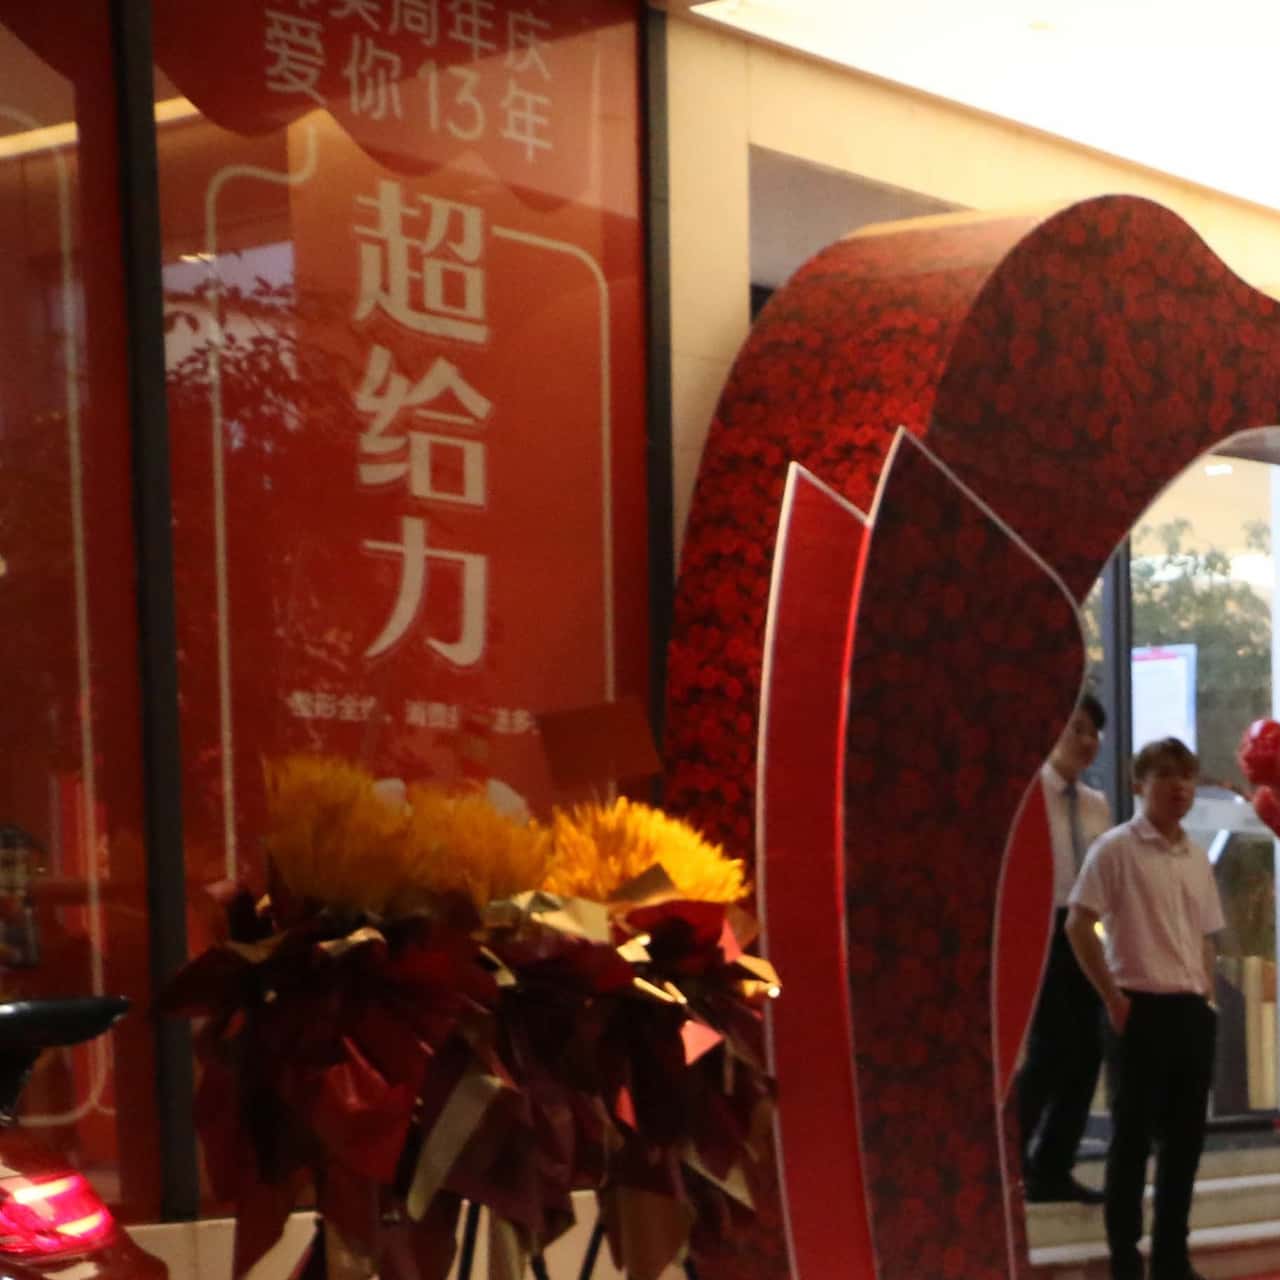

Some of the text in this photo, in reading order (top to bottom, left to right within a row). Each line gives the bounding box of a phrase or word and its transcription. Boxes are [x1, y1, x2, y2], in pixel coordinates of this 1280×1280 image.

[264, 8, 553, 163] 爱你13年
[350, 178, 493, 668] 超给力
